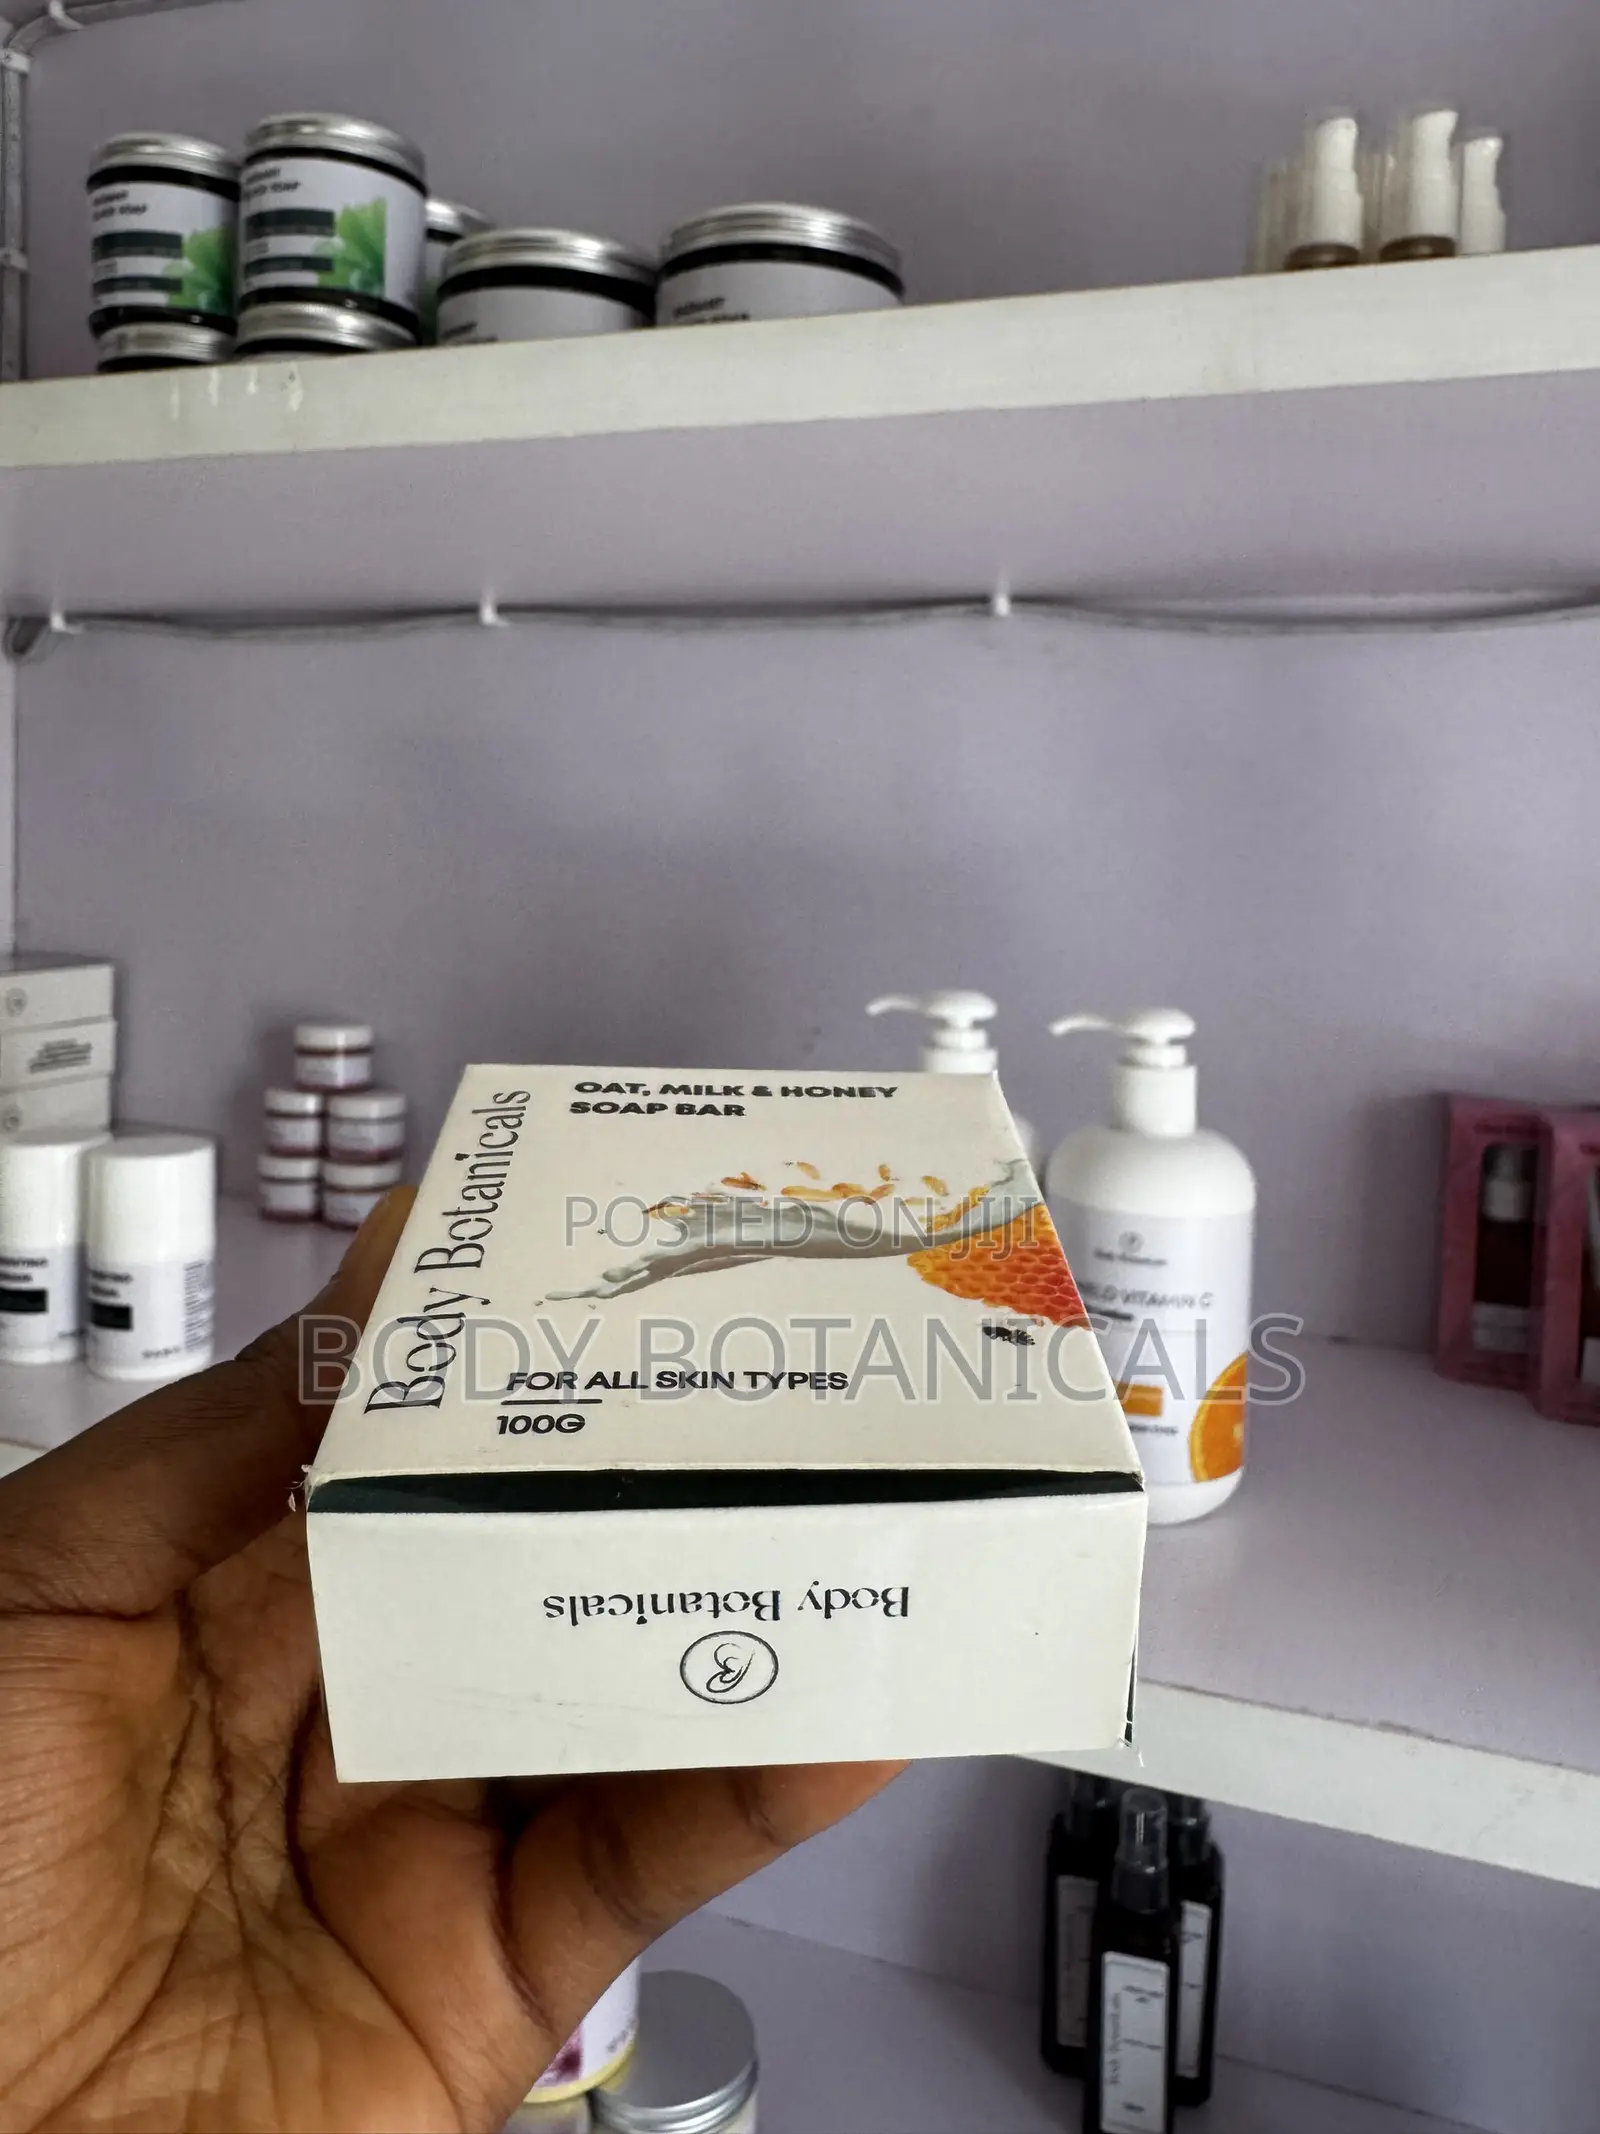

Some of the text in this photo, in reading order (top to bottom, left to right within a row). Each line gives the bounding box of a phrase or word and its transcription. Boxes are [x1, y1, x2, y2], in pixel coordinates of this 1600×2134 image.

[573, 1081, 898, 1098] OAT, MILK & HONEY
[569, 1100, 746, 1116] SOAP BAR
[363, 1089, 531, 1414] Body Botanicals
[506, 1371, 849, 1391] FOR ALL SKIN TYPES
[497, 1413, 586, 1435] 100G
[543, 1581, 908, 1627] Body Botanicals
